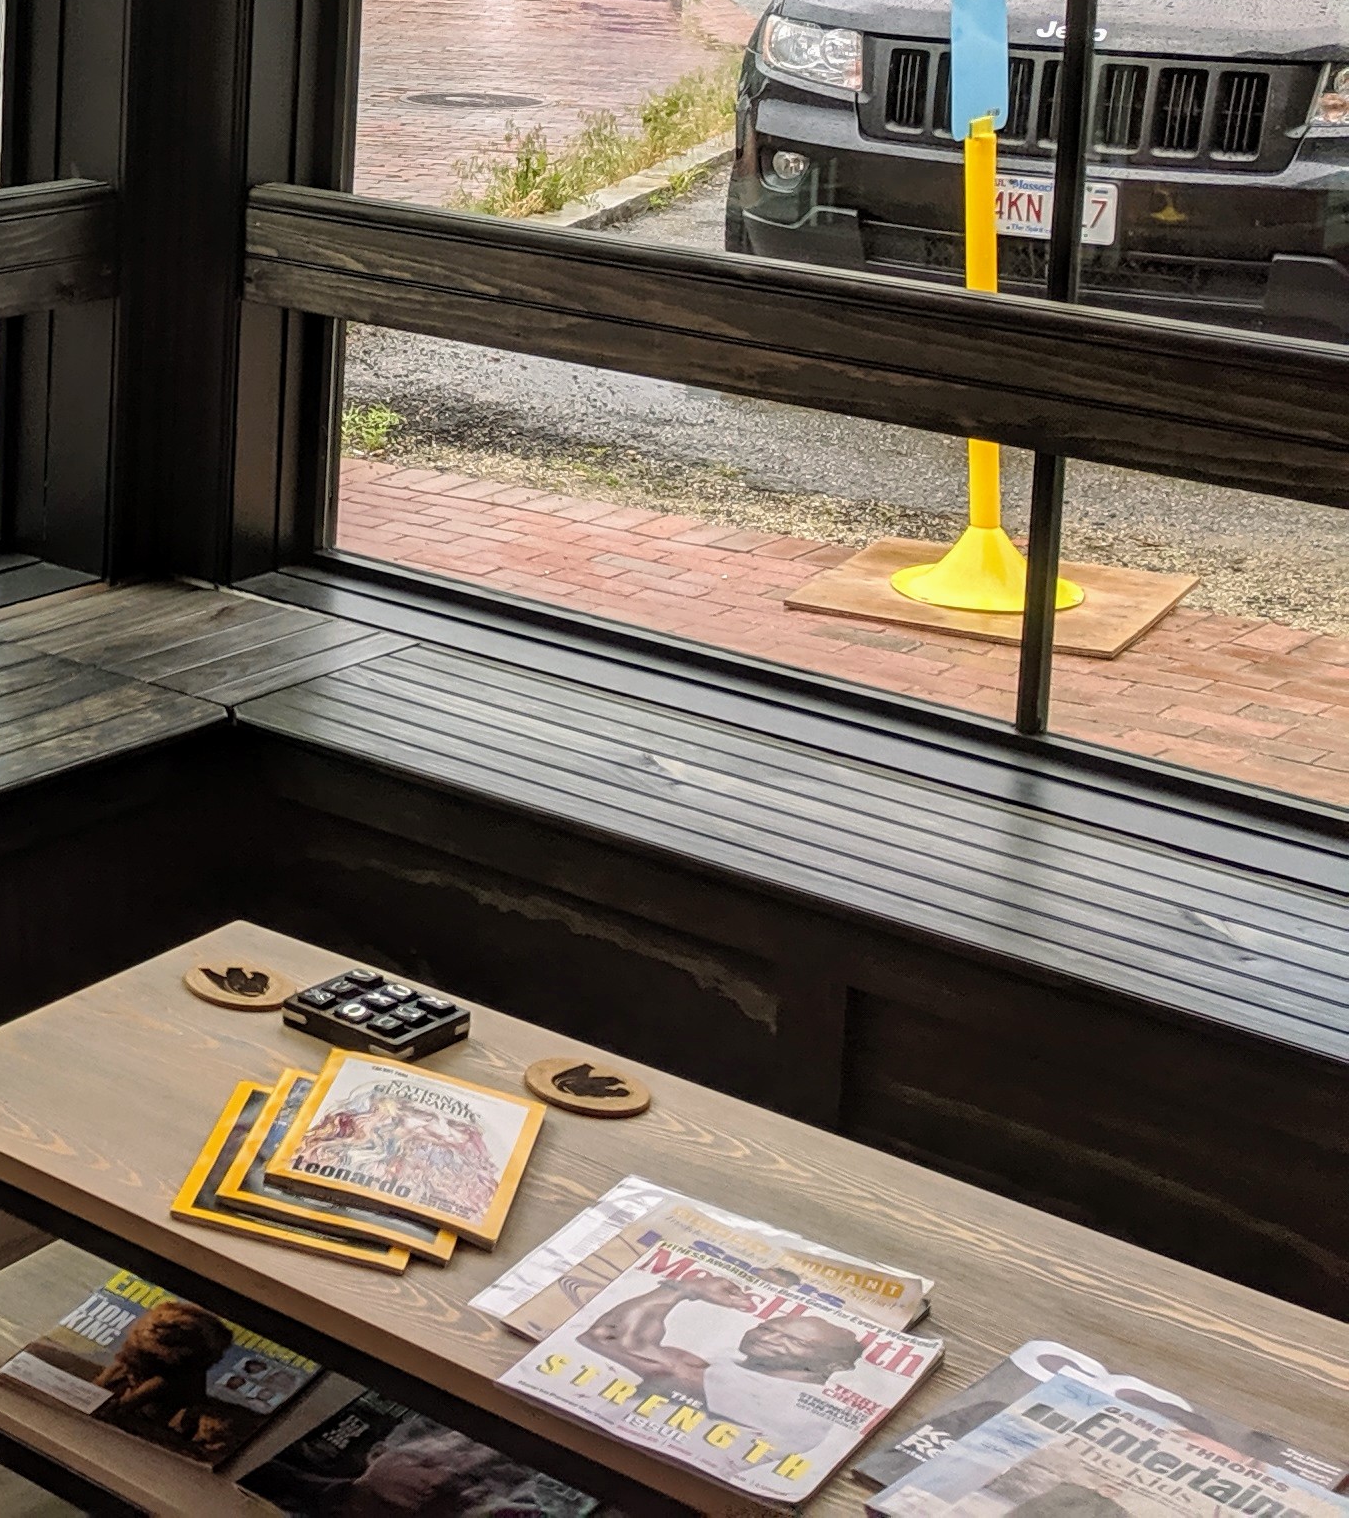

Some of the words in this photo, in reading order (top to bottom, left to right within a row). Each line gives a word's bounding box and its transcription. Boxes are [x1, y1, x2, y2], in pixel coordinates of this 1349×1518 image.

[1036, 20, 1108, 42] Jep
[389, 1079, 472, 1111] NATIONAL
[290, 1154, 413, 1199] Leonardo
[535, 1354, 814, 1482] STRENGTH
[1103, 1405, 1169, 1439] GAME
[1185, 1442, 1290, 1494] THRONES
[1071, 1411, 1311, 1518] Entertain
